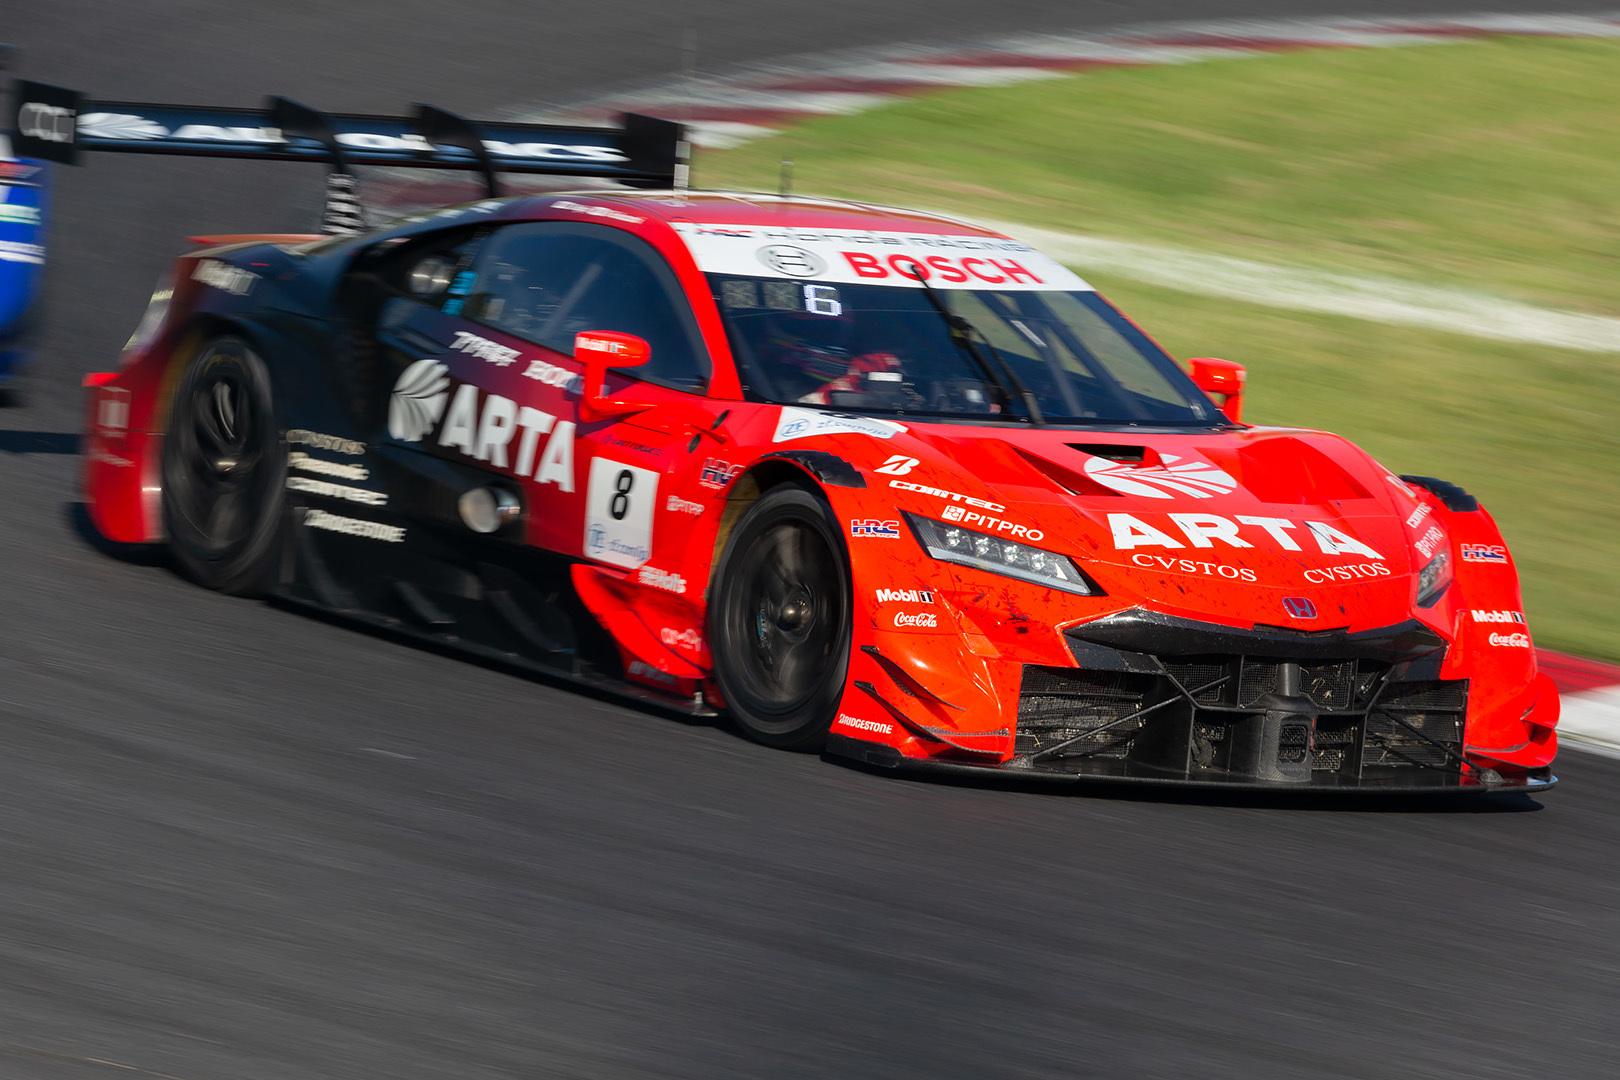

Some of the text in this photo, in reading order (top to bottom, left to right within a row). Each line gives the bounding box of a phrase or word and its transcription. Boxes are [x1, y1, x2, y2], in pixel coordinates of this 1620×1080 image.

[839, 251, 1046, 285] BOSCH
[804, 285, 842, 317] 6
[438, 384, 577, 492] ARTA
[610, 469, 633, 520] 8
[889, 480, 1006, 513] COMTEC
[964, 511, 1044, 541] PITPRO
[1106, 513, 1386, 560] ARTA
[1132, 554, 1391, 584] CVSTOS CVSTOS
[876, 588, 935, 603] Mobil 1
[894, 611, 937, 628] Coca-Cola
[1471, 610, 1513, 623] Mobil
[1489, 632, 1529, 648] Coca-Cola
[838, 713, 894, 734] BRIDGESTONE
